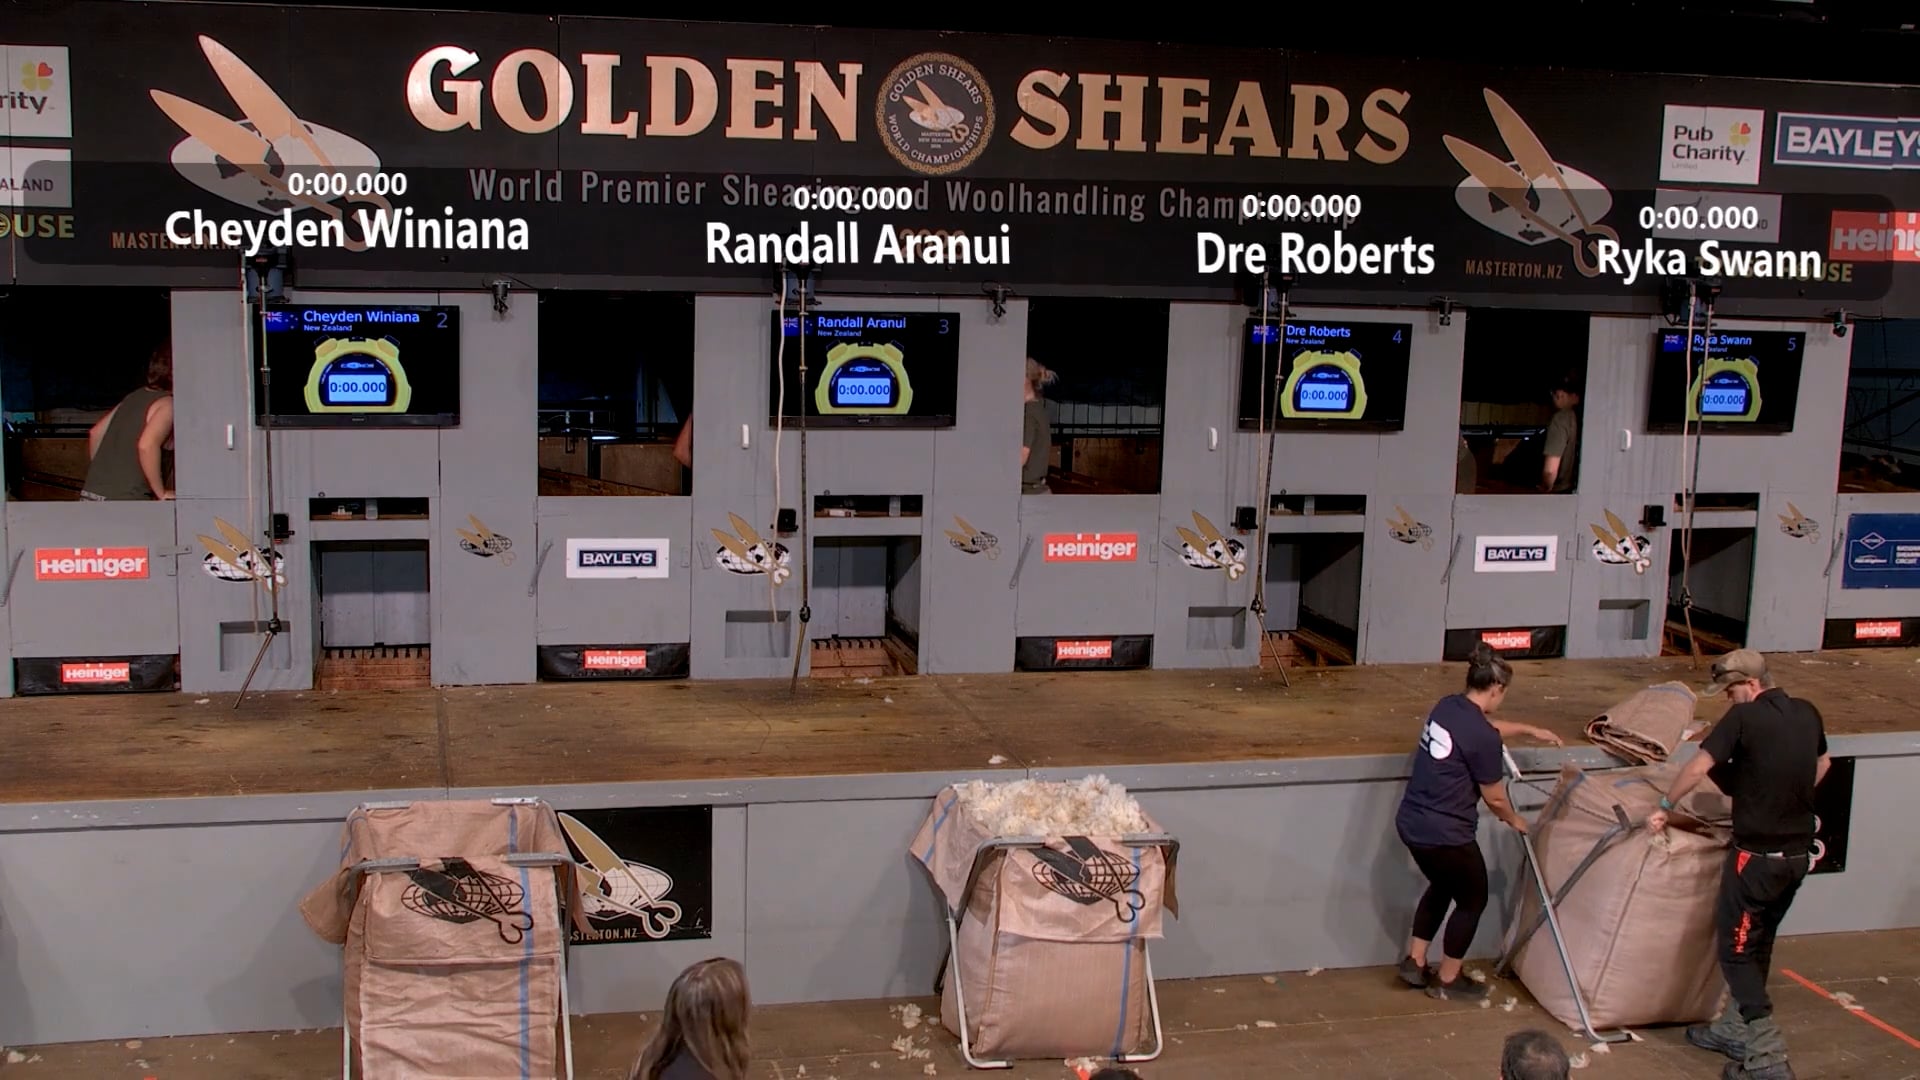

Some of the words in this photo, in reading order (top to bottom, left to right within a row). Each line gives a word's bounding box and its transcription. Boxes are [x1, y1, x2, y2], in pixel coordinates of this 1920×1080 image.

[889, 64, 935, 102] GOLDEN
[938, 64, 983, 104] SHEARS
[406, 45, 863, 142] GOLDEN
[1010, 69, 1412, 165] SHEARS
[888, 113, 911, 151] WORLD
[910, 115, 984, 165] CHAMPIONSHIPS
[1674, 125, 1713, 141] Pub
[1786, 125, 1920, 158] BAYLEY
[1672, 143, 1745, 166] Charity
[469, 168, 562, 202] World
[581, 171, 706, 205] Premier
[945, 181, 1146, 223] Woolhandling
[1465, 259, 1563, 280] MASTERTON.NZ
[303, 310, 362, 324] Cheyden
[366, 311, 420, 323] Winiana
[436, 312, 448, 328] 2
[818, 316, 863, 328] Randall
[867, 317, 906, 329] Aranui
[322, 324, 353, 332] Zealand
[938, 319, 949, 334] 3
[1287, 325, 1306, 336] Dre
[1309, 326, 1351, 338] Roberts
[1392, 330, 1403, 344] 4
[1720, 335, 1752, 345] Swann
[1787, 337, 1797, 351] 5
[330, 382, 386, 393] 0:00.000
[838, 384, 890, 395] 0:00.000
[1301, 390, 1348, 401] 0:00.000
[1704, 395, 1745, 405] 0:00.000
[1047, 533, 1136, 560] Heiniger
[583, 552, 653, 566] BAYLEYS
[1487, 549, 1544, 560] BAYLEYS
[40, 548, 147, 577] Heiniger
[1856, 622, 1899, 636] Heiniger
[1058, 641, 1111, 656] Heiniger
[587, 650, 645, 667] Heiniger
[65, 663, 129, 680] Heiniger
